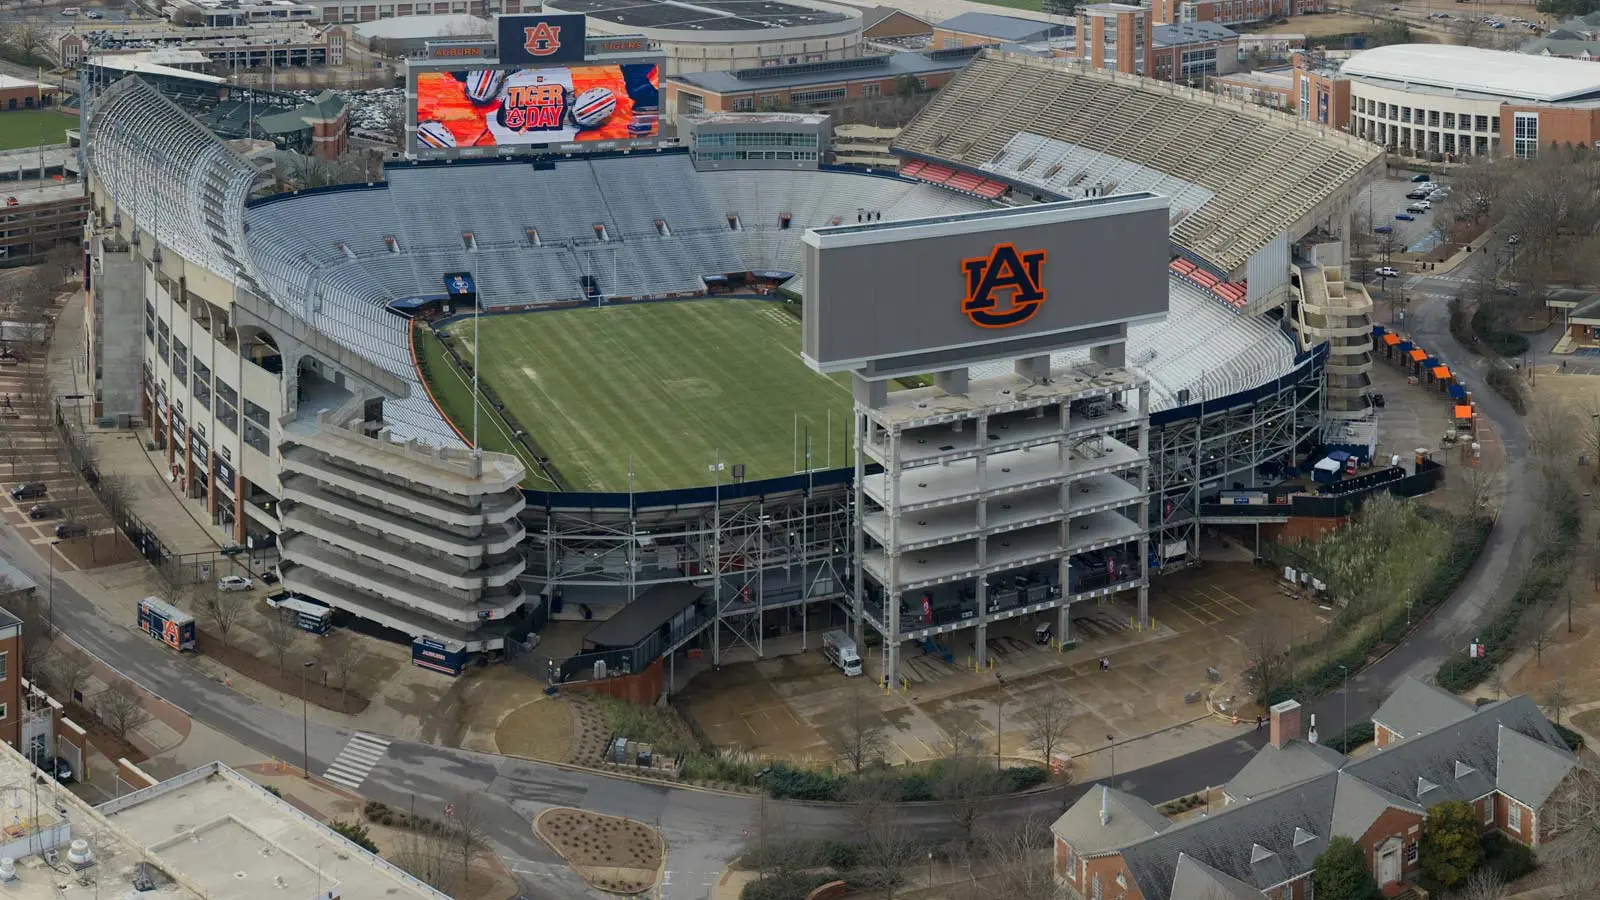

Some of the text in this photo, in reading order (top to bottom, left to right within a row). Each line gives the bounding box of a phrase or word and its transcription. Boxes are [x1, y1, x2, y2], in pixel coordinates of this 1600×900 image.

[435, 47, 480, 57] AUBURN
[508, 84, 563, 107] TIGER
[526, 106, 563, 127] DAY
